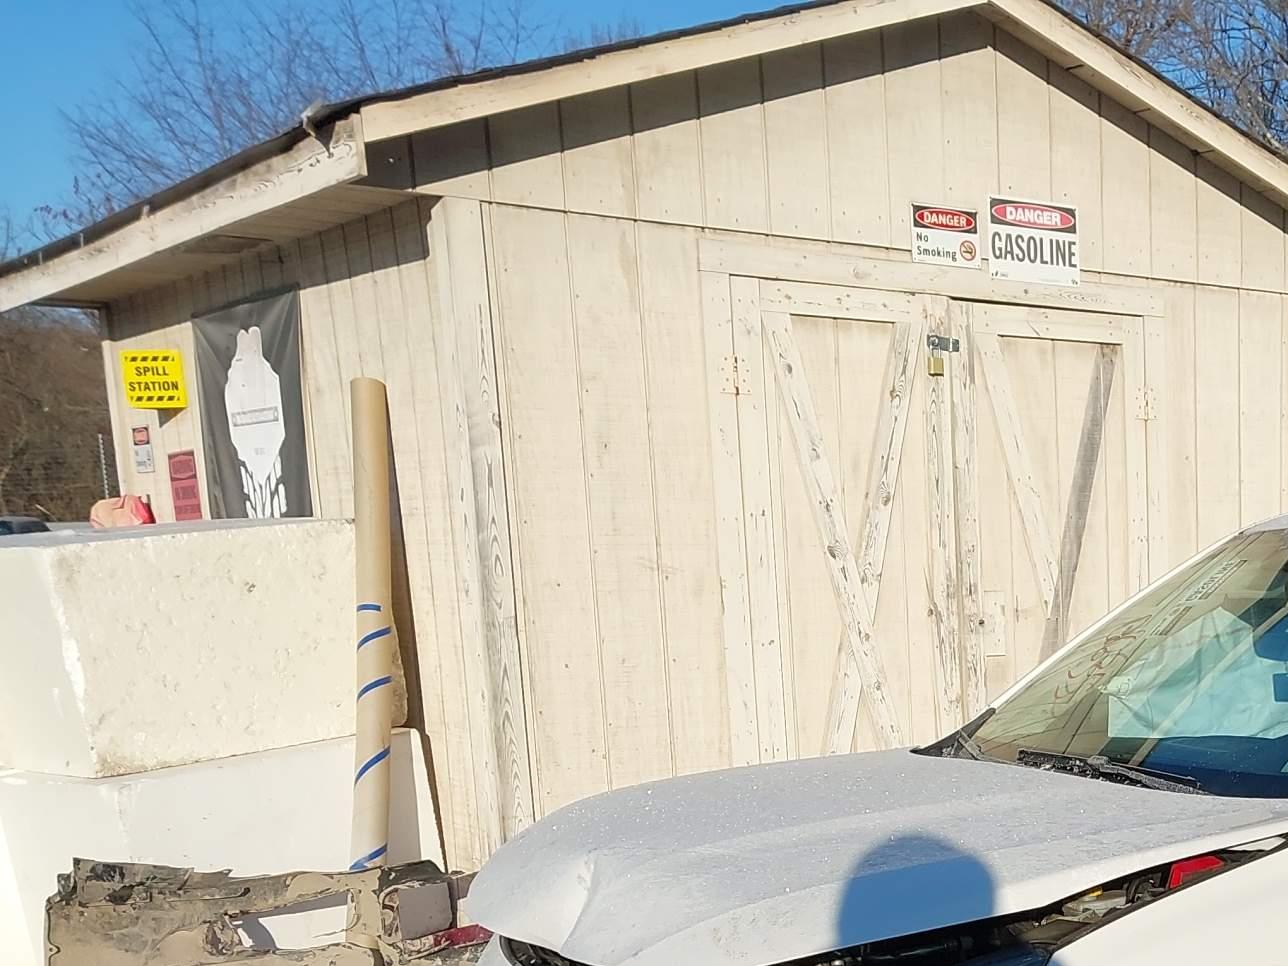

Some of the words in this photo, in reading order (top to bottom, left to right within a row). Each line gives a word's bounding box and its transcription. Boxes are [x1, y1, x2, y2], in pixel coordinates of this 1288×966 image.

[923, 211, 967, 228] DANGER
[1006, 206, 1062, 226] DANGER
[916, 231, 929, 243] No
[916, 245, 957, 263] Smoking
[991, 231, 1078, 268] GASOLINE
[134, 366, 169, 377] SPILL
[128, 381, 179, 392] STATION
